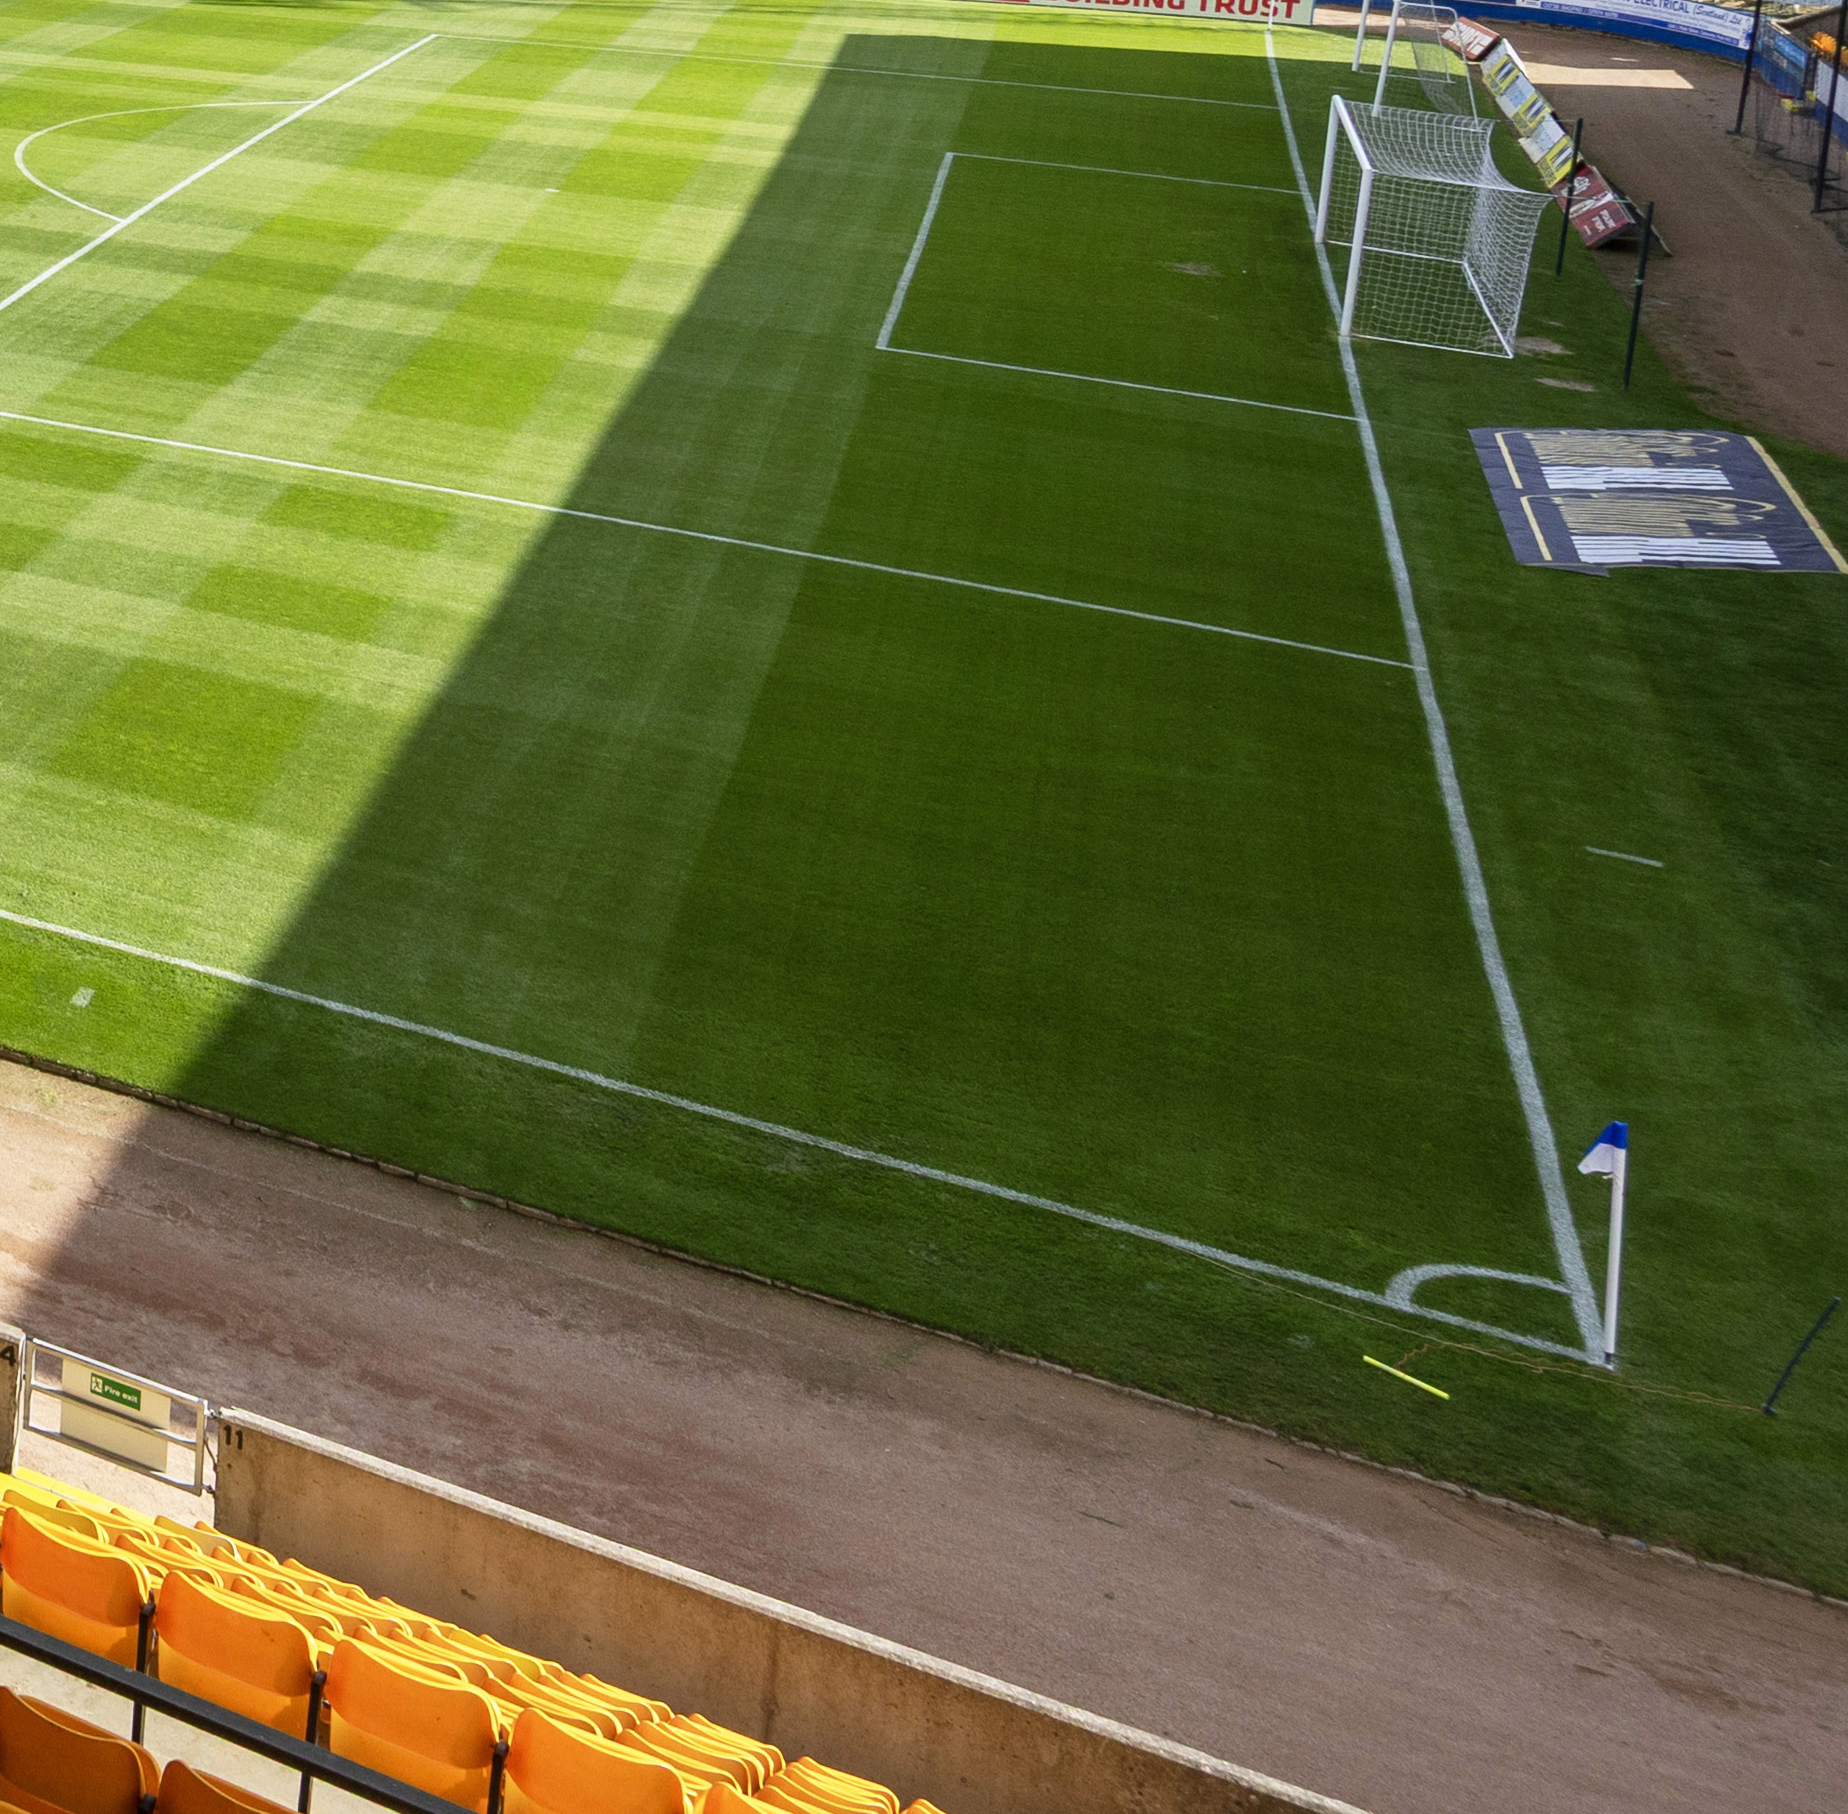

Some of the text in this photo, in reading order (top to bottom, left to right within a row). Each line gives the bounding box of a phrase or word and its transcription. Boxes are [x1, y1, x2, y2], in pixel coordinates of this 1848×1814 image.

[104, 1384, 138, 1404] Fire exit
[223, 1425, 244, 1450] 11
